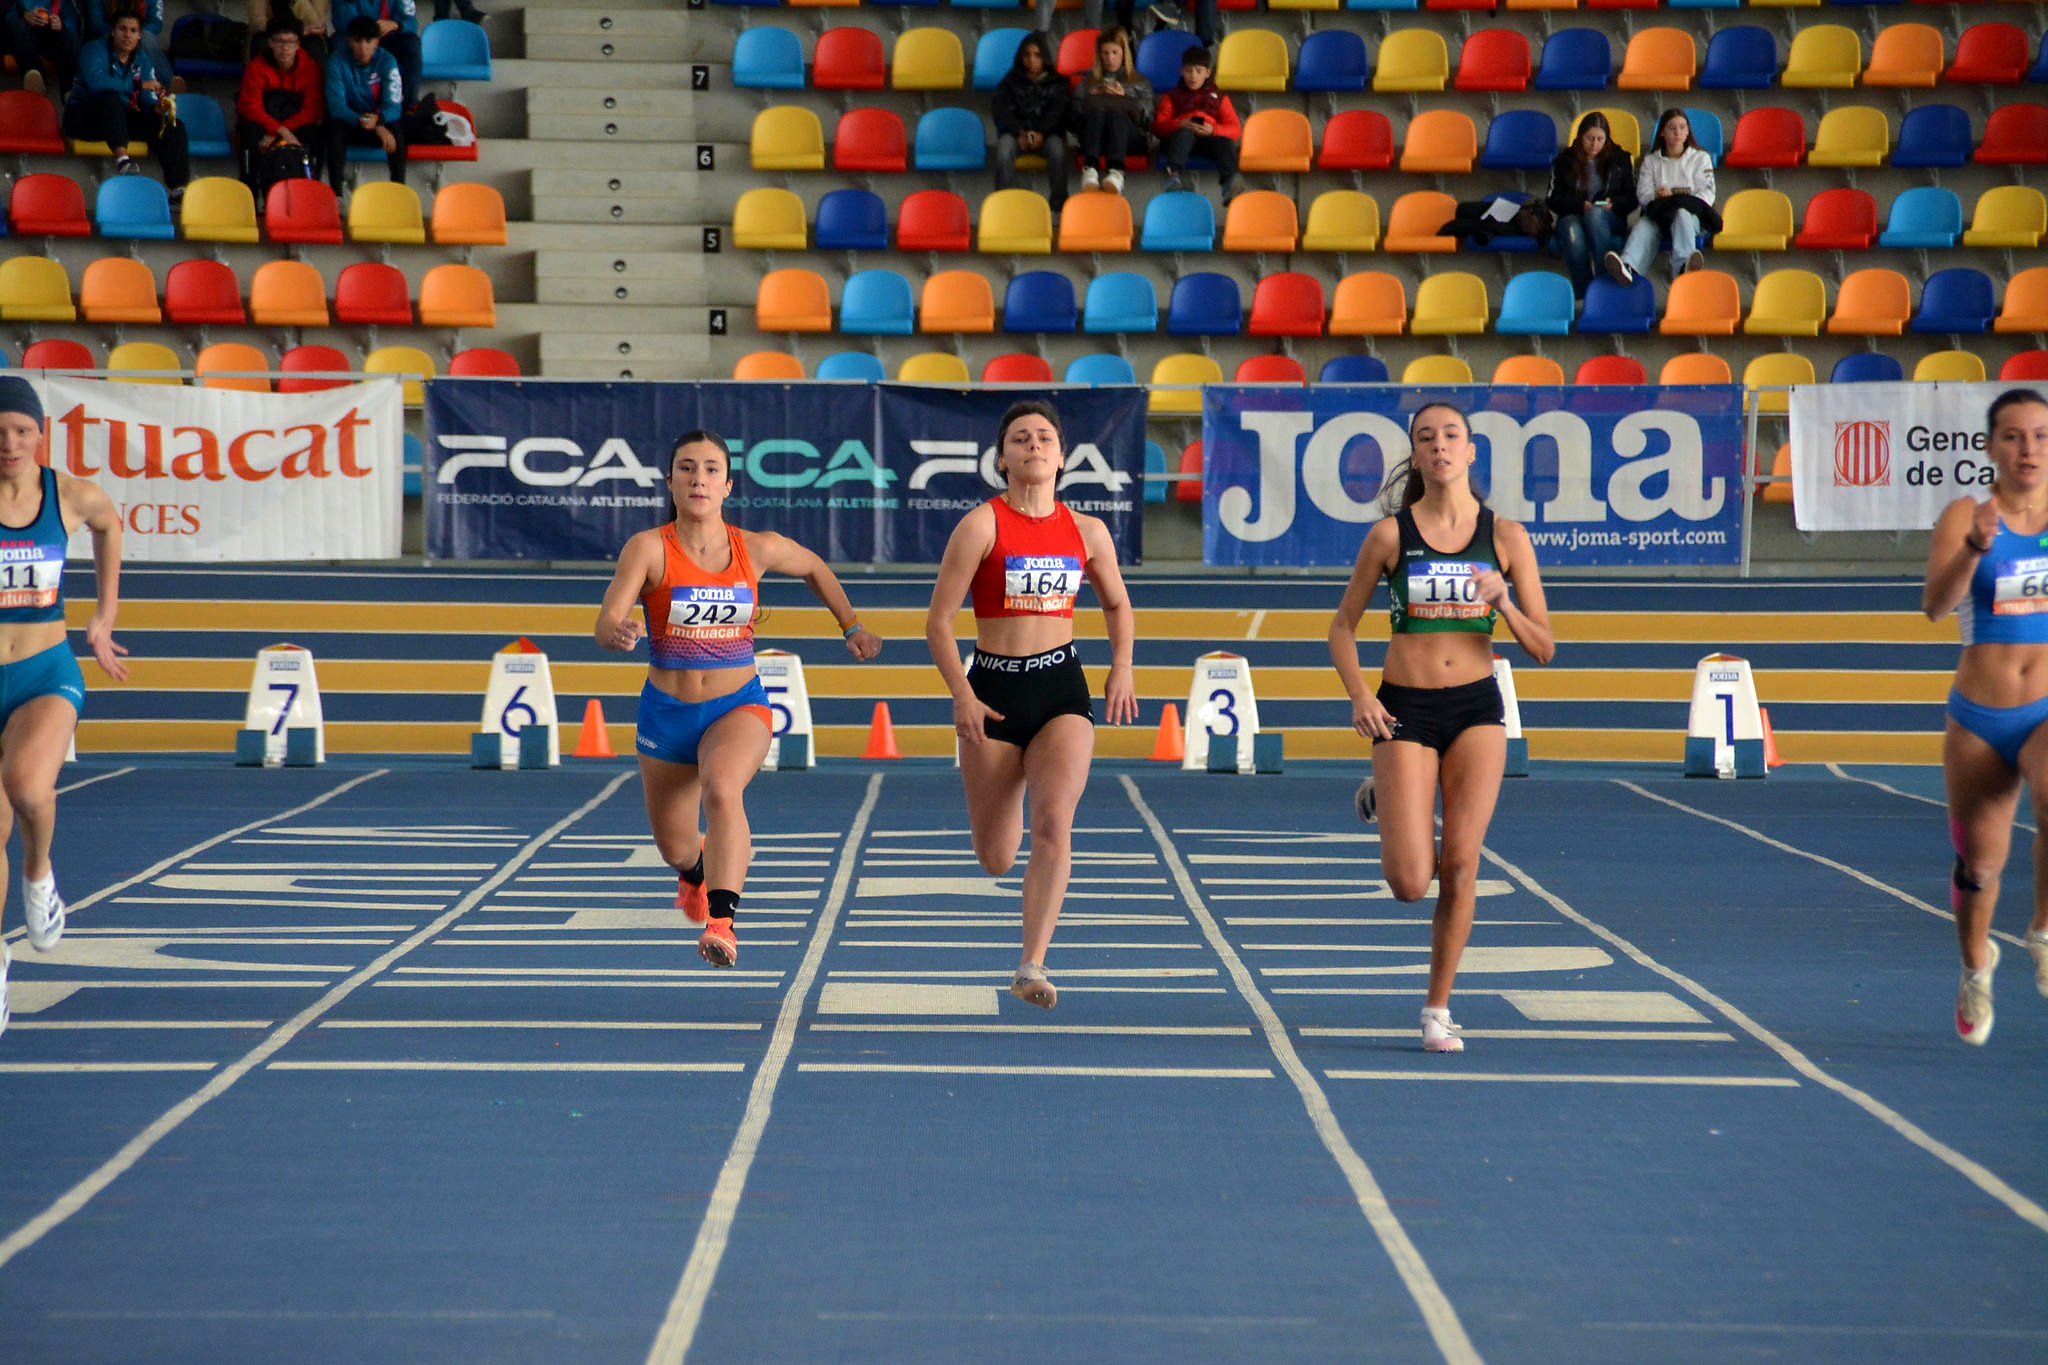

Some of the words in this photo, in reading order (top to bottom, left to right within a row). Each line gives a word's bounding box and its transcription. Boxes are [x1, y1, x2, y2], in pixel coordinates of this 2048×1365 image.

[695, 71, 706, 86] 7
[700, 150, 711, 166] 6
[706, 233, 718, 249] 5
[712, 314, 724, 330] 4
[1906, 425, 1989, 452] Gene
[437, 435, 664, 487] FCA
[728, 438, 899, 489] CA
[1906, 459, 1943, 486] de
[1953, 459, 1996, 486] Ca
[517, 496, 588, 507] CATALANA
[589, 496, 665, 508] ATLETISME
[827, 499, 899, 509] ATLETISME
[1021, 572, 1068, 595] 164
[683, 603, 737, 625] 242
[671, 625, 741, 639] mutuacat
[976, 653, 1021, 672] NIKE
[1025, 651, 1065, 672] PRO
[267, 684, 300, 737] 7
[501, 685, 538, 738] 6
[1205, 688, 1240, 736] 3
[1715, 694, 1735, 746] 1
